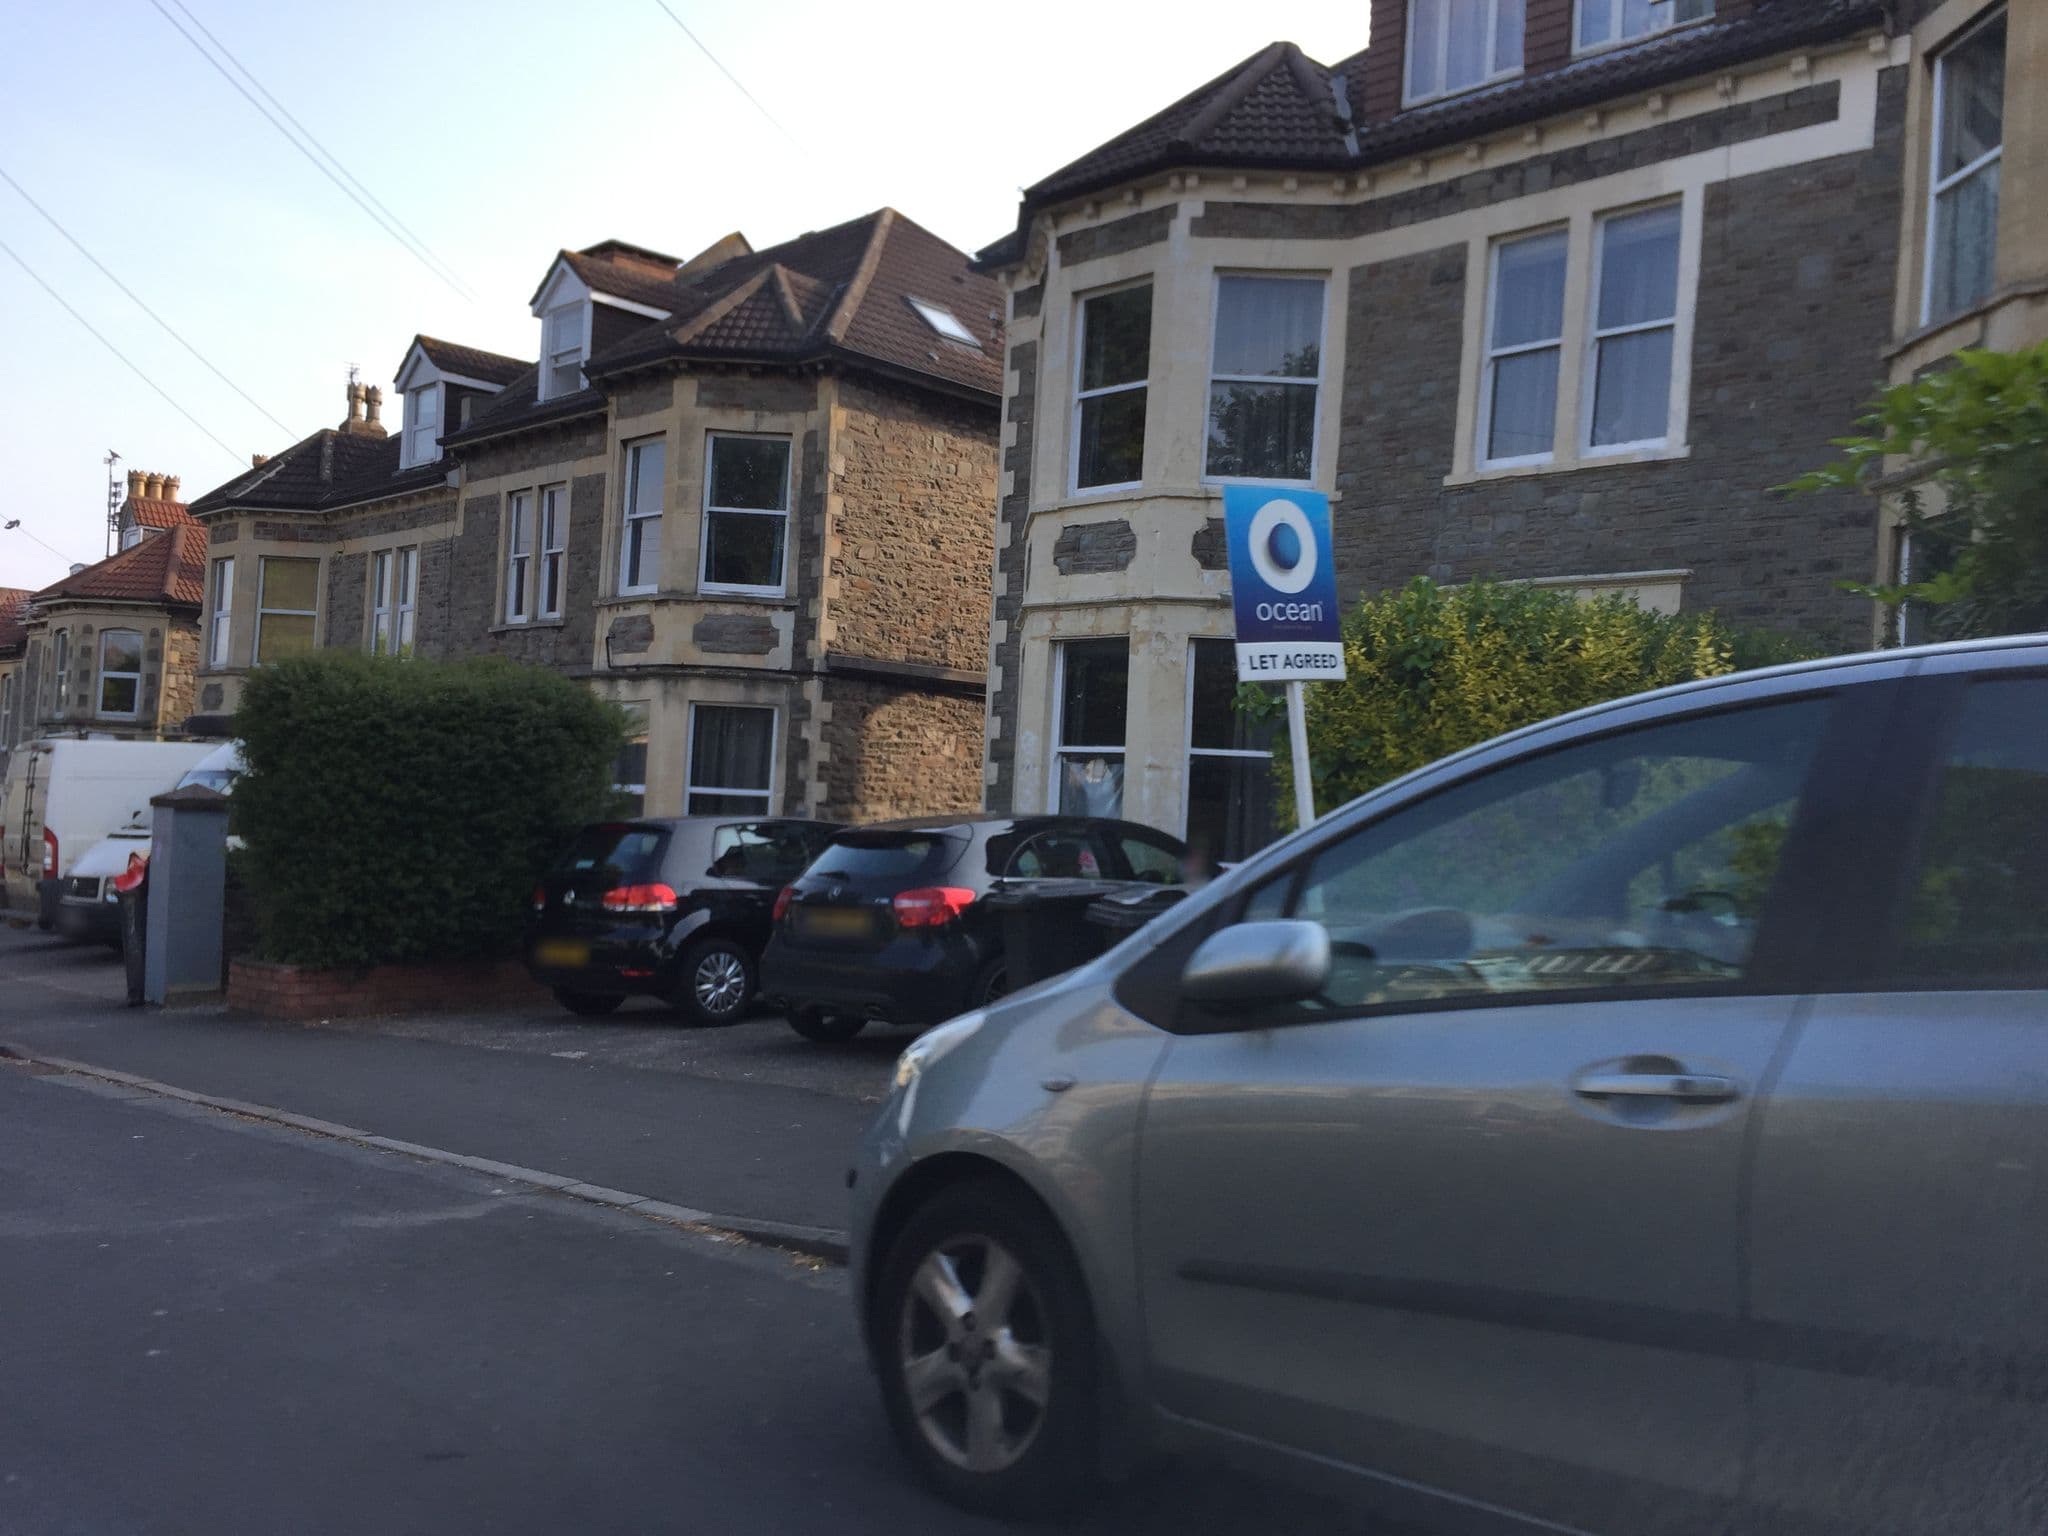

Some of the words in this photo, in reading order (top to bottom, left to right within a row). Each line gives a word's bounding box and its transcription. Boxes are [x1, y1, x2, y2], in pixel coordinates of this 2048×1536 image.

[1256, 603, 1322, 621] ocean
[1250, 654, 1278, 670] LET
[1284, 653, 1338, 669] AGREED
